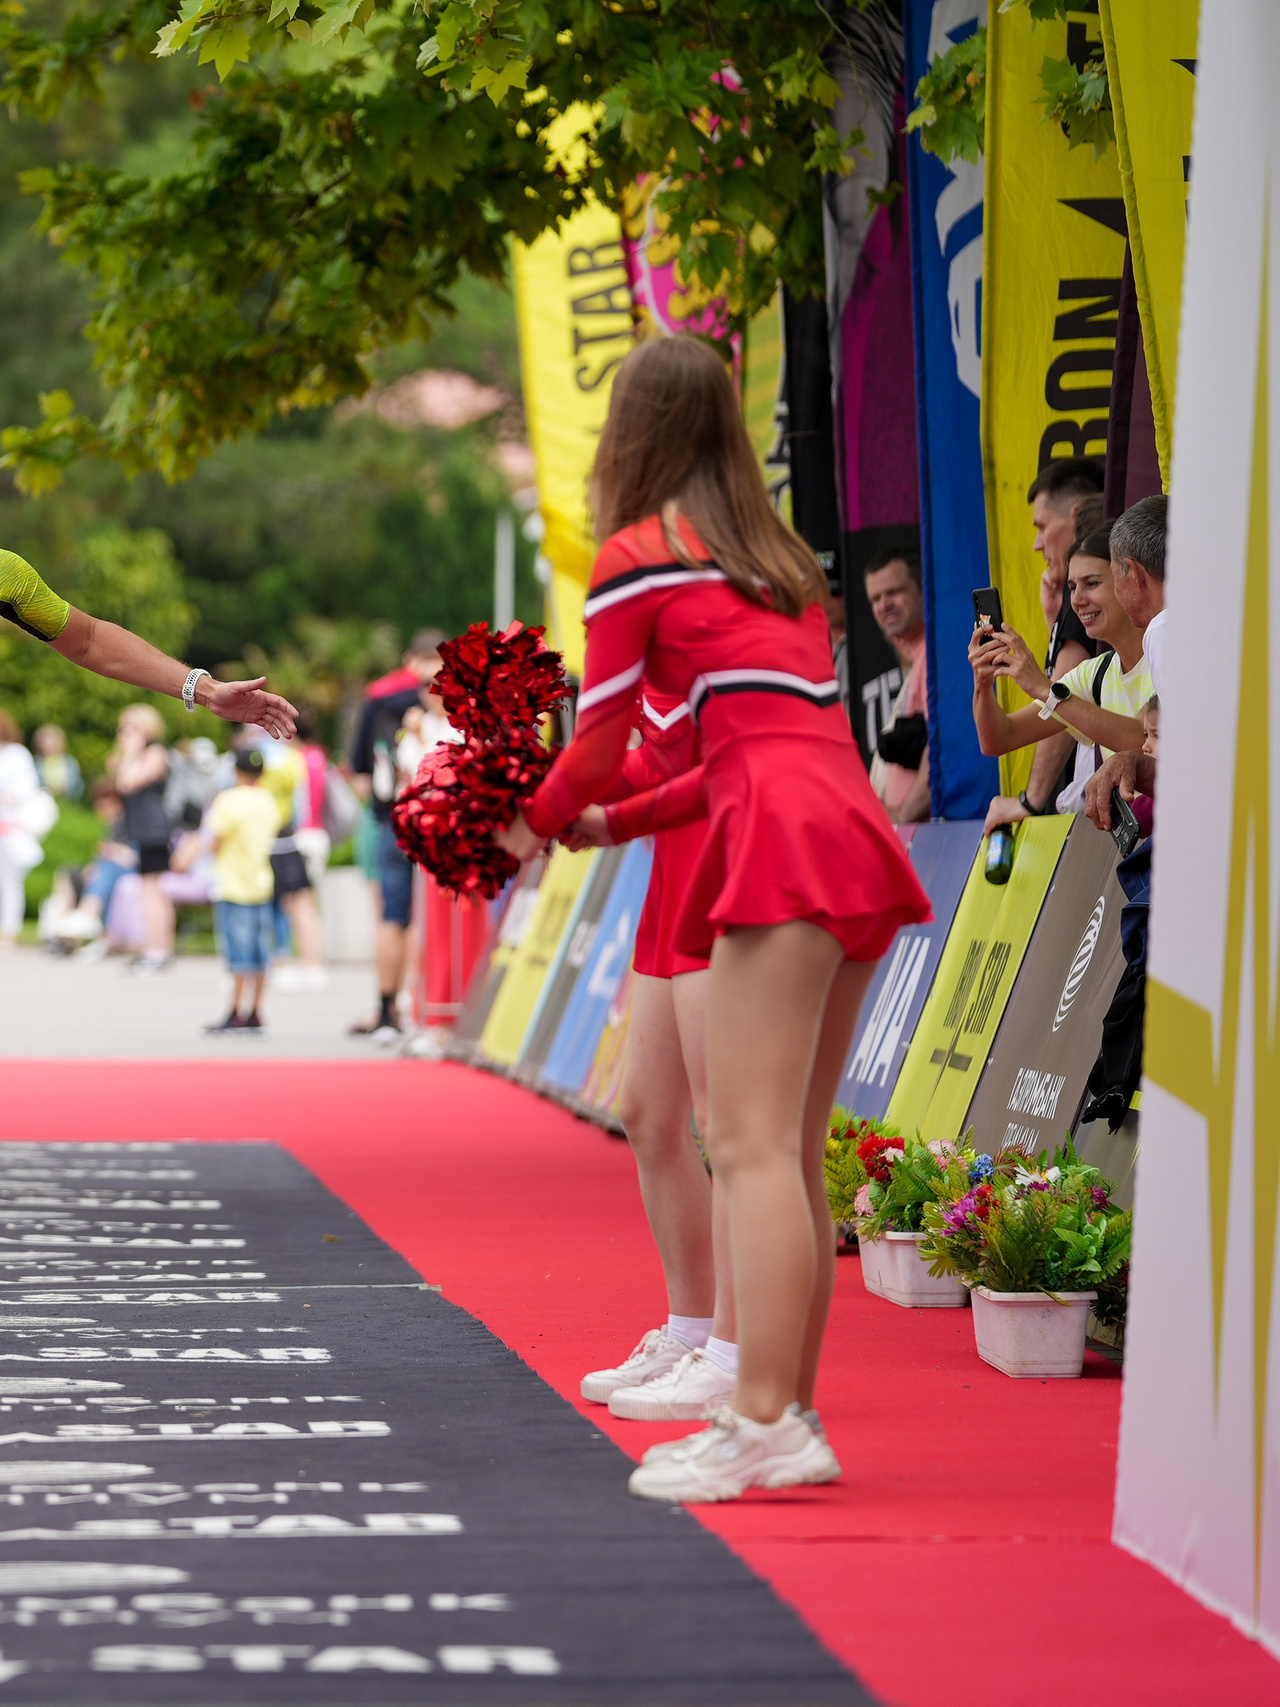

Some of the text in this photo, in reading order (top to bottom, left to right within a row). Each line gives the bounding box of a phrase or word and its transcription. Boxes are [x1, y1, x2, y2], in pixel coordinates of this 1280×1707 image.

[568, 240, 634, 391] STAR
[964, 939, 1013, 1035] STAR
[1006, 1067, 1067, 1120] ГАЗПРОМБАНК
[22, 1291, 280, 1302] STAR
[38, 1347, 331, 1360] STAR
[54, 1420, 392, 1437] STAR
[73, 1513, 462, 1536] STAR
[91, 1643, 560, 1676] STAR
